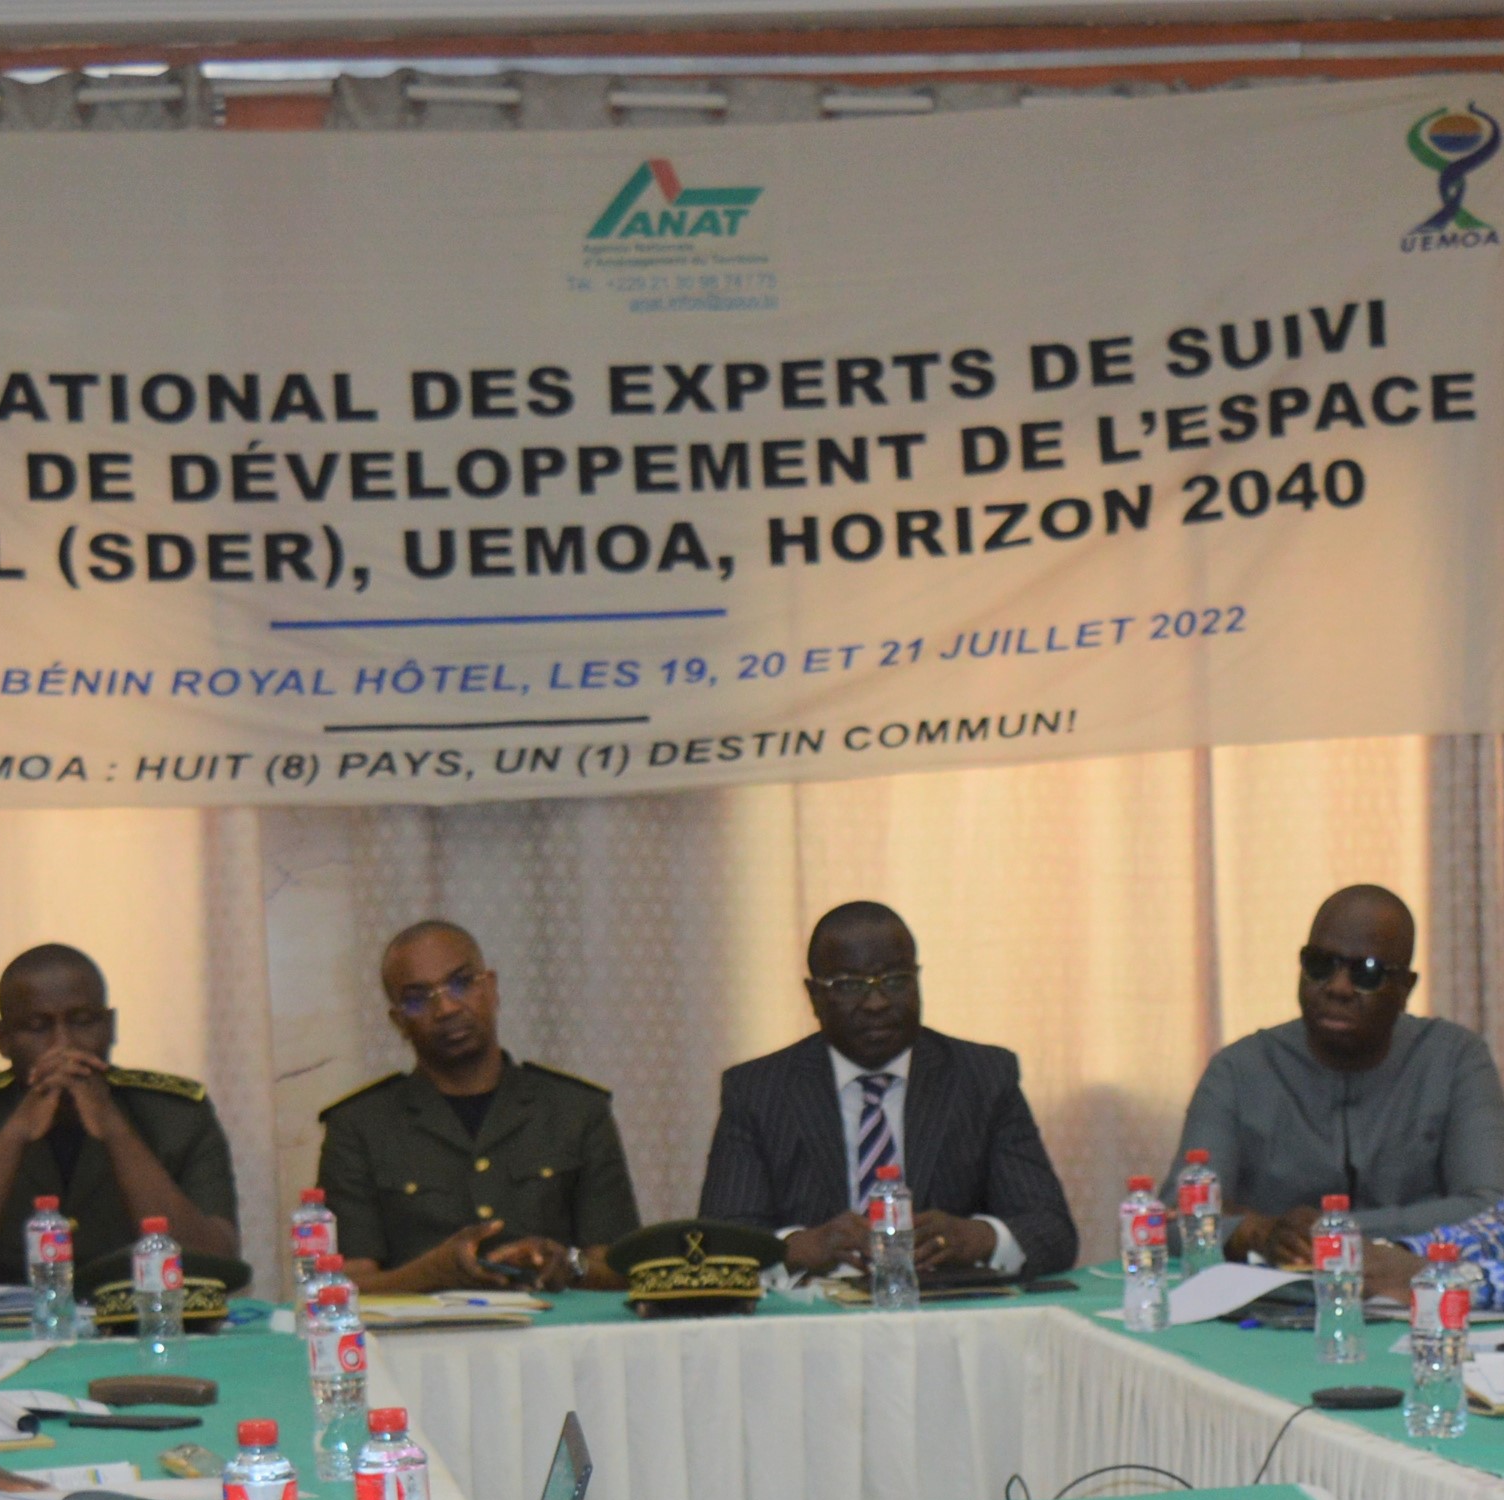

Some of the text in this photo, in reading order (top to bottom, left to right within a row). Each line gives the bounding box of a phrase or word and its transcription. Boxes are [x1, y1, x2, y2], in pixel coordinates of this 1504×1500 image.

[619, 208, 750, 238] ANAT
[1400, 230, 1500, 253] UEMOA
[410, 365, 575, 422] DES
[608, 347, 997, 416] EXPERTS
[1029, 335, 1135, 393] DE
[1165, 298, 1387, 379] SUIVI
[25, 451, 135, 503] DE
[168, 431, 927, 502] DÉVELOPPEMENT
[960, 419, 1066, 477] DE
[57, 523, 370, 593] (SDER),
[403, 520, 735, 582] UEMOA,
[767, 483, 1154, 567] HORIZON
[1180, 458, 1366, 526] 2040
[0, 658, 153, 696] BÉNIN
[171, 668, 333, 696] ROYAL
[353, 656, 530, 698] HÔTEL,
[549, 660, 640, 689] LES
[661, 657, 717, 686] 19,
[738, 652, 785, 679] 20
[803, 646, 861, 673] ET
[880, 638, 923, 667] 21
[939, 615, 1134, 660] JUILLET
[1151, 605, 1245, 639] 2022
[135, 753, 252, 781] HUIT
[265, 753, 320, 786] (8)
[338, 749, 473, 780] PAYS,
[494, 746, 562, 774] UN
[576, 743, 630, 777] (1)
[648, 729, 825, 767] DESTIN
[843, 709, 1076, 751] COMMUN!
